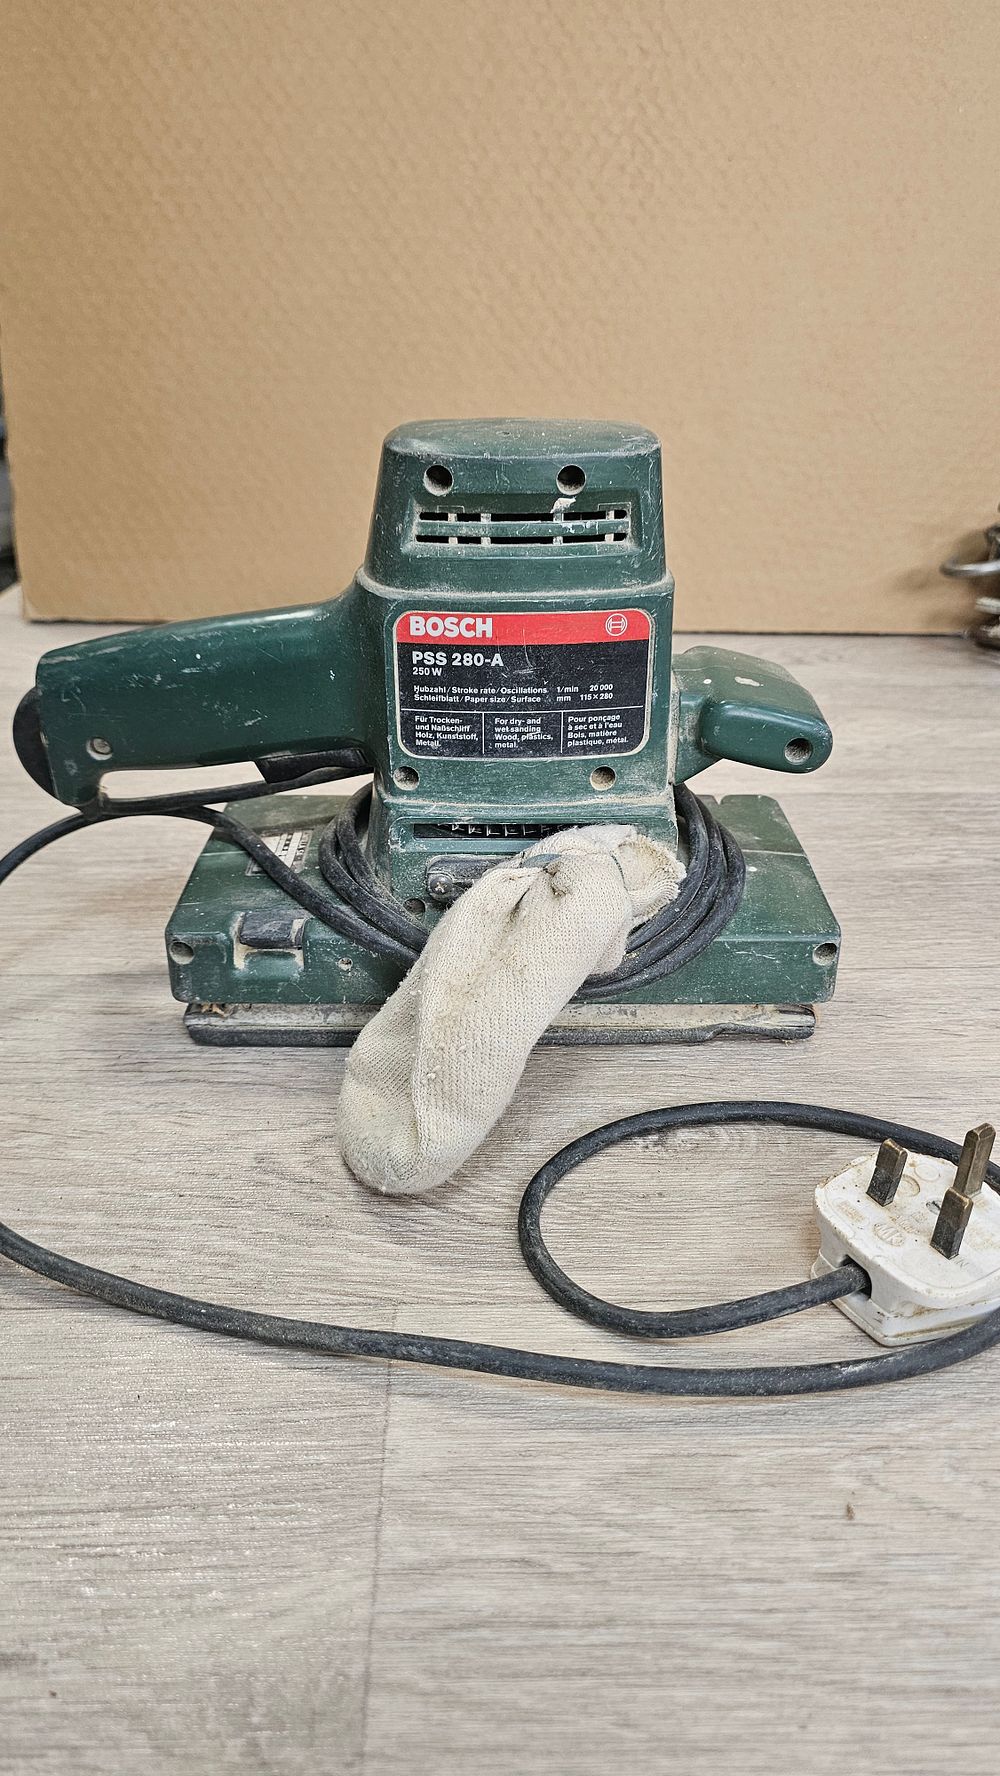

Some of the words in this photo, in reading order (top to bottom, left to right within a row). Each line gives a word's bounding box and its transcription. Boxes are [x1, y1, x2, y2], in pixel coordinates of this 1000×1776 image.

[409, 615, 493, 638] BOSCH
[412, 650, 447, 666] PSS
[451, 651, 504, 667] 280-A
[412, 667, 430, 676] 250
[431, 668, 442, 676] W
[429, 716, 463, 724] Trocken-
[494, 717, 508, 725] For
[509, 717, 525, 726] dry-
[588, 714, 621, 724] ponçage
[431, 724, 471, 732] Naßschliff
[510, 725, 541, 733] sanding
[415, 731, 435, 739] Holz,
[436, 732, 479, 741] Kunststoff,
[494, 733, 520, 743] Wood,
[521, 733, 554, 742] plastics,
[567, 731, 587, 739] Bois,
[588, 730, 618, 738] matière
[567, 738, 605, 748] plastique,
[605, 736, 629, 744] métal.
